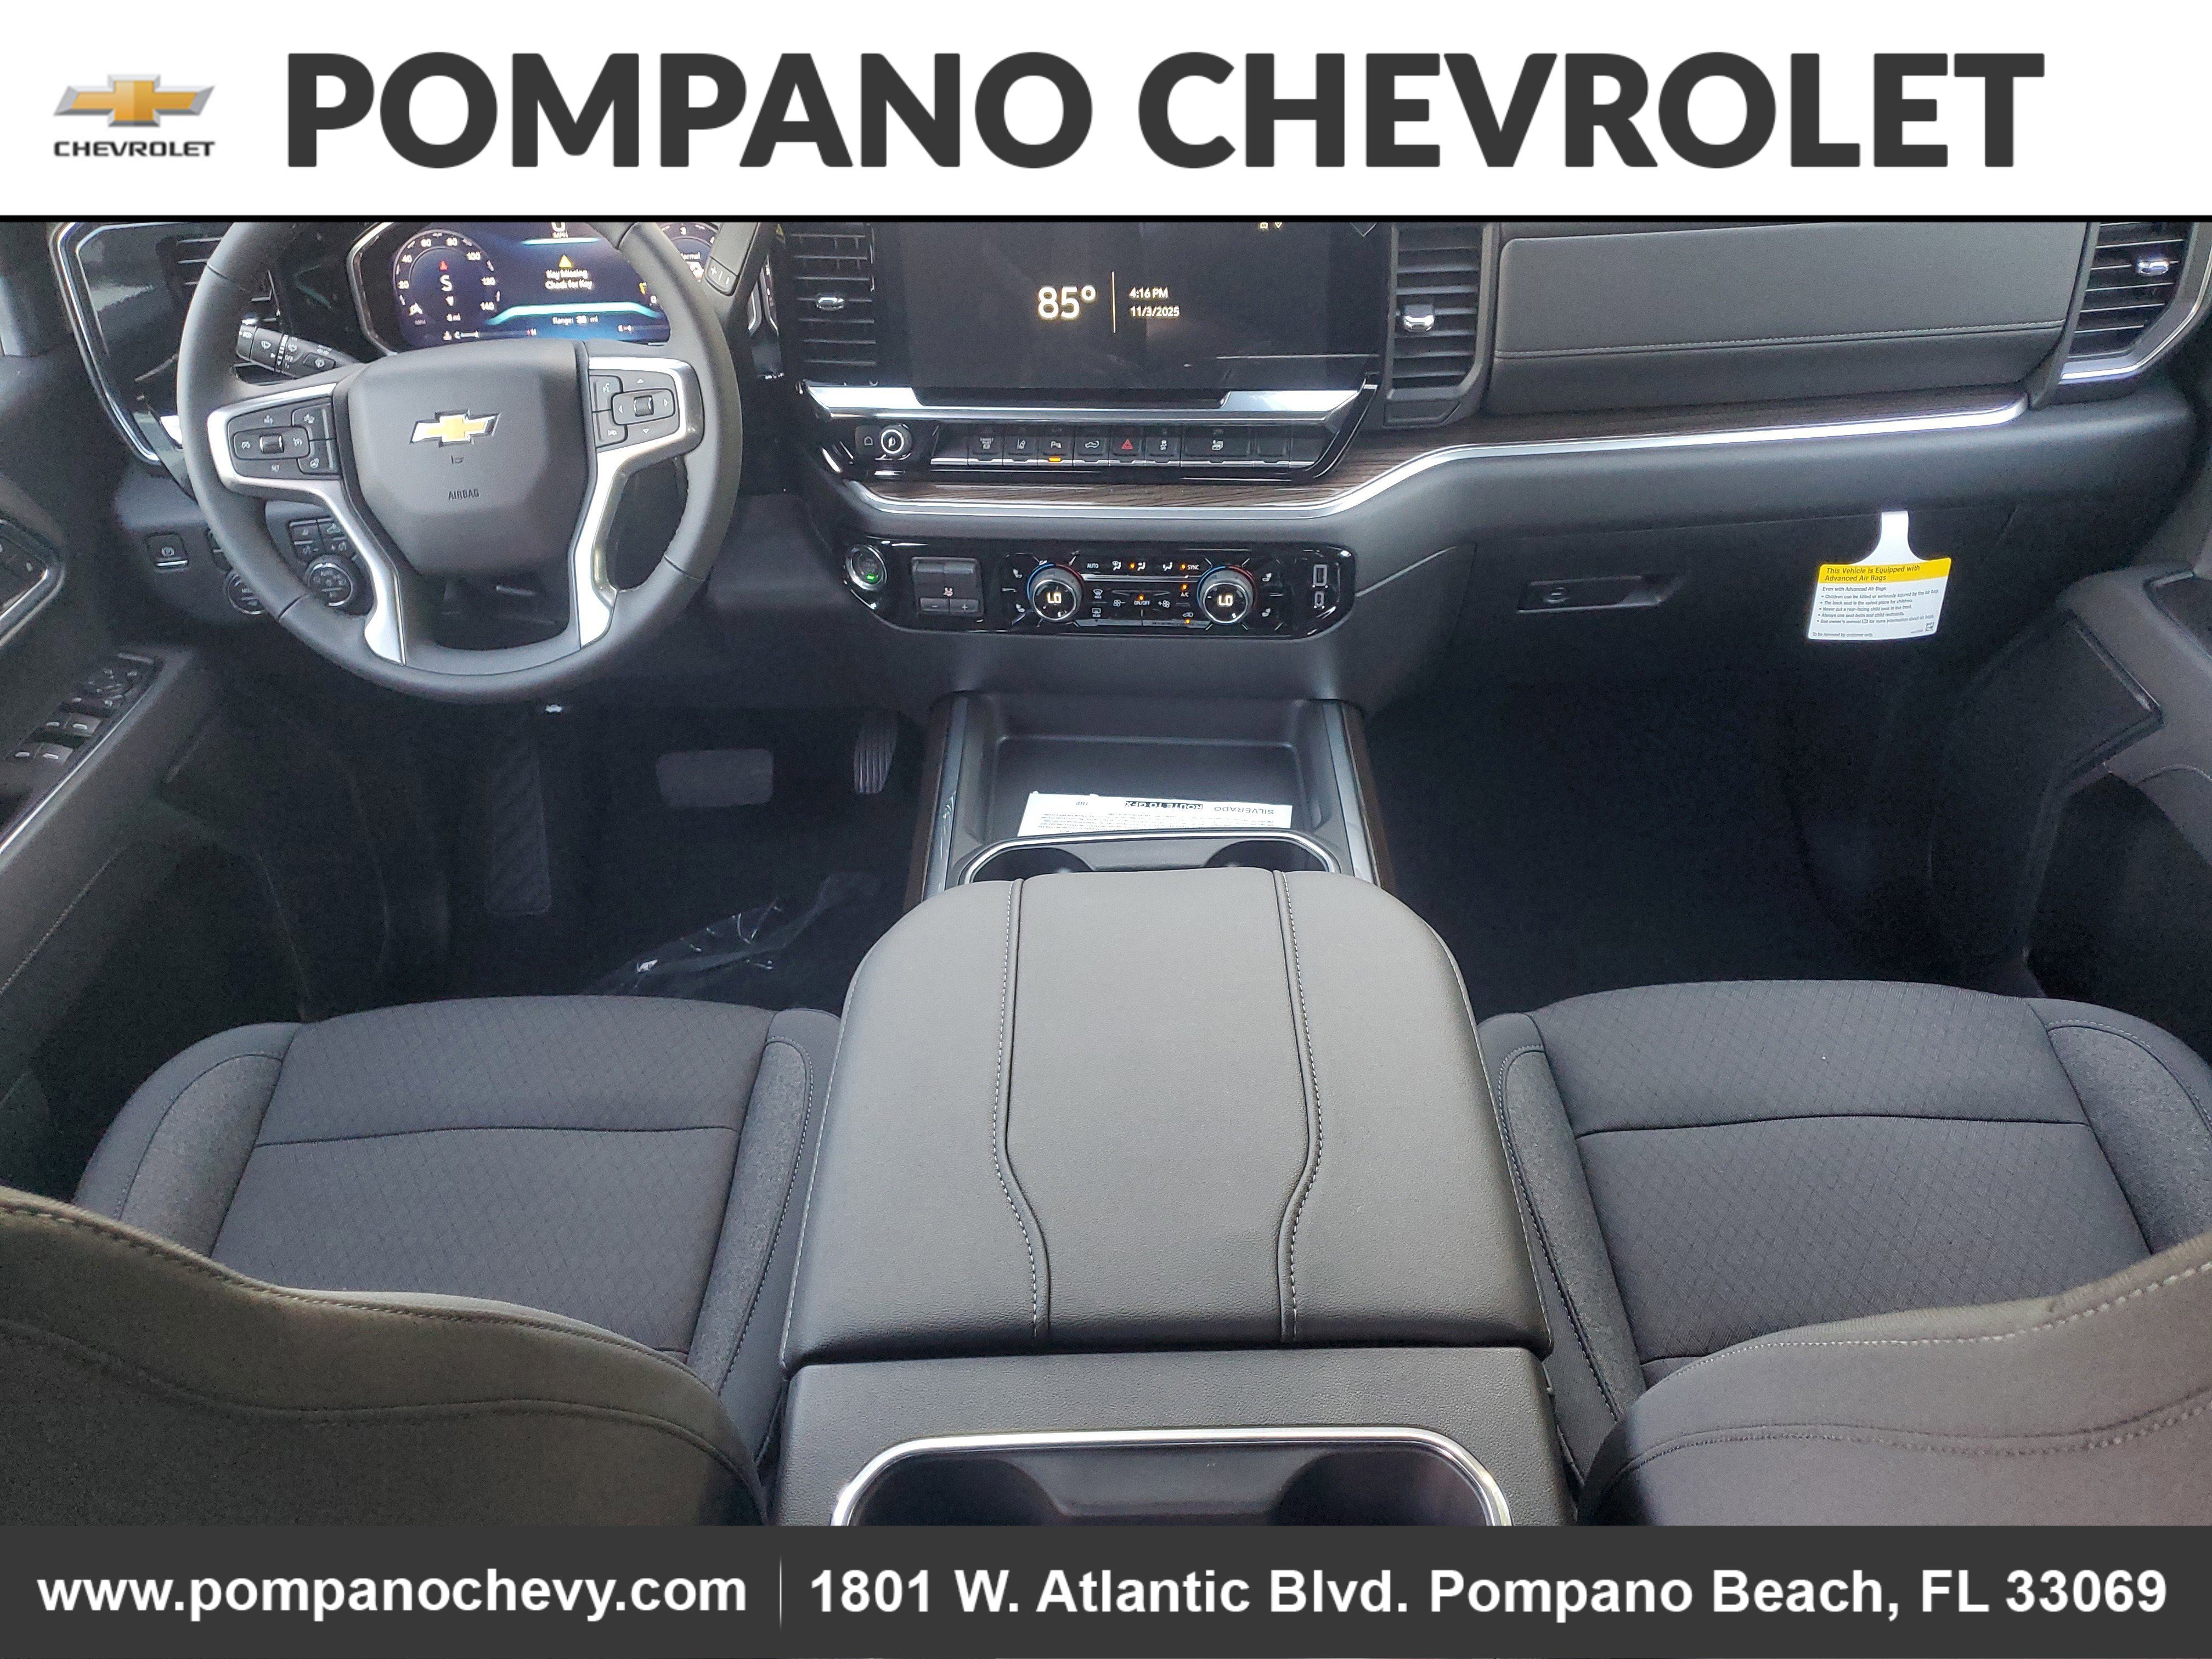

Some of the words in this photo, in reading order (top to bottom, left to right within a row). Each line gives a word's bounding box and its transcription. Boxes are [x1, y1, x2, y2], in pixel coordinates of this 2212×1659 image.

[440, 275, 453, 291] S
[1128, 286, 1151, 298] 4:16
[1152, 286, 1169, 298] PM
[1130, 305, 1180, 317] 11/3/2025
[448, 488, 481, 500] AIRBAG
[1875, 566, 1905, 574] Equipped
[1214, 806, 1274, 815] SILVERADO
